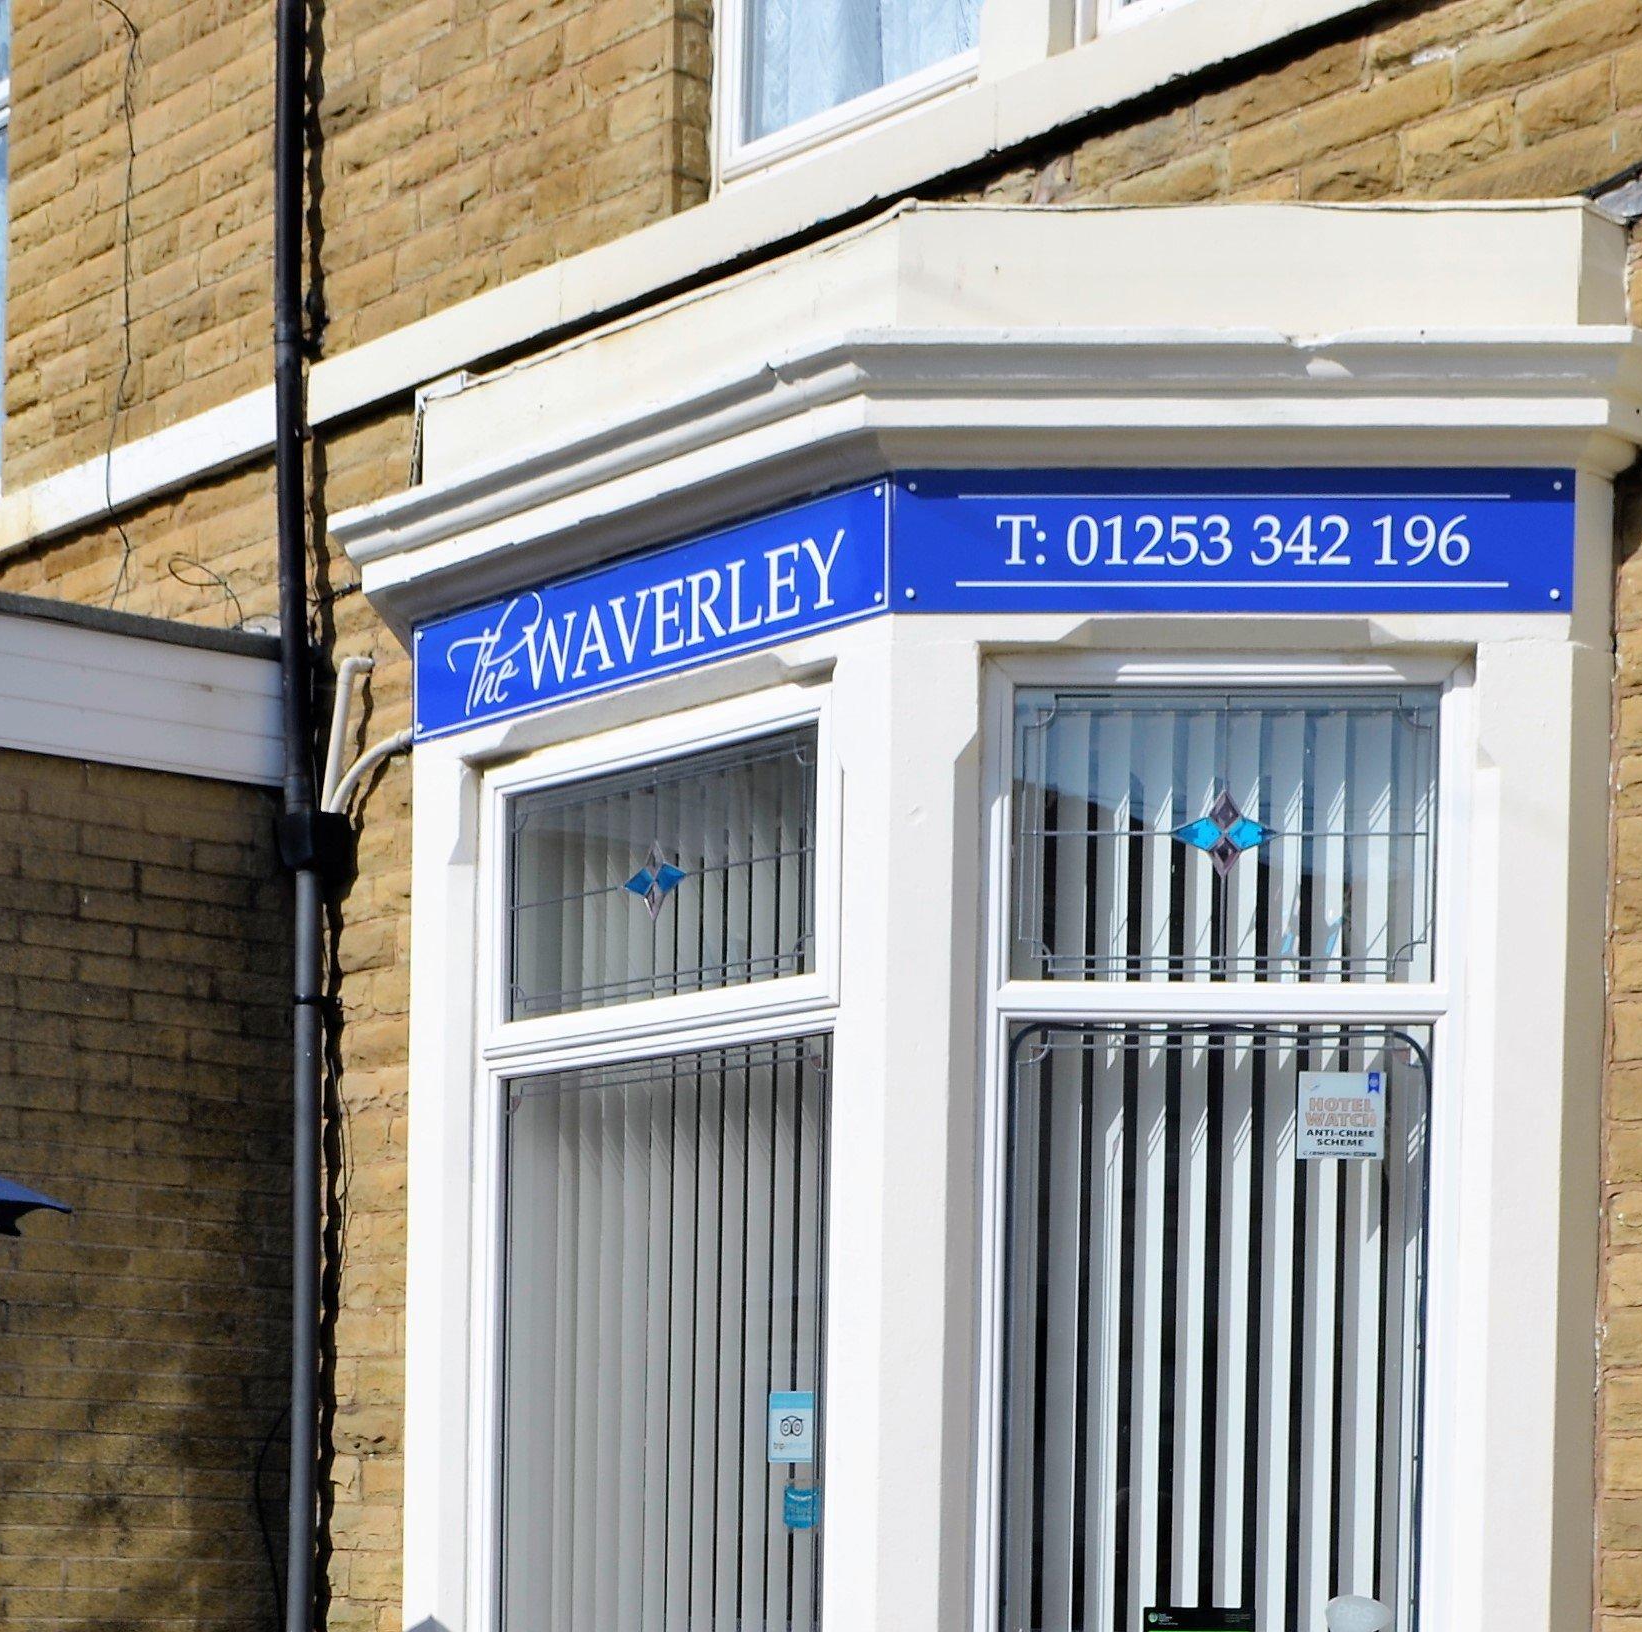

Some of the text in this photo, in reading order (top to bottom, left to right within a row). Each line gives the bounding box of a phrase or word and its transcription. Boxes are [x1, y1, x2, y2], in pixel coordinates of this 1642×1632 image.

[996, 513, 1471, 567] T: 01253 342 196
[447, 528, 846, 717] The WAVERLEY
[1309, 1097, 1374, 1112] HOTEL
[1305, 1112, 1376, 1127] WATCH
[1306, 1129, 1375, 1138] ANTI-CRIME
[1316, 1138, 1365, 1147] SCHEME
